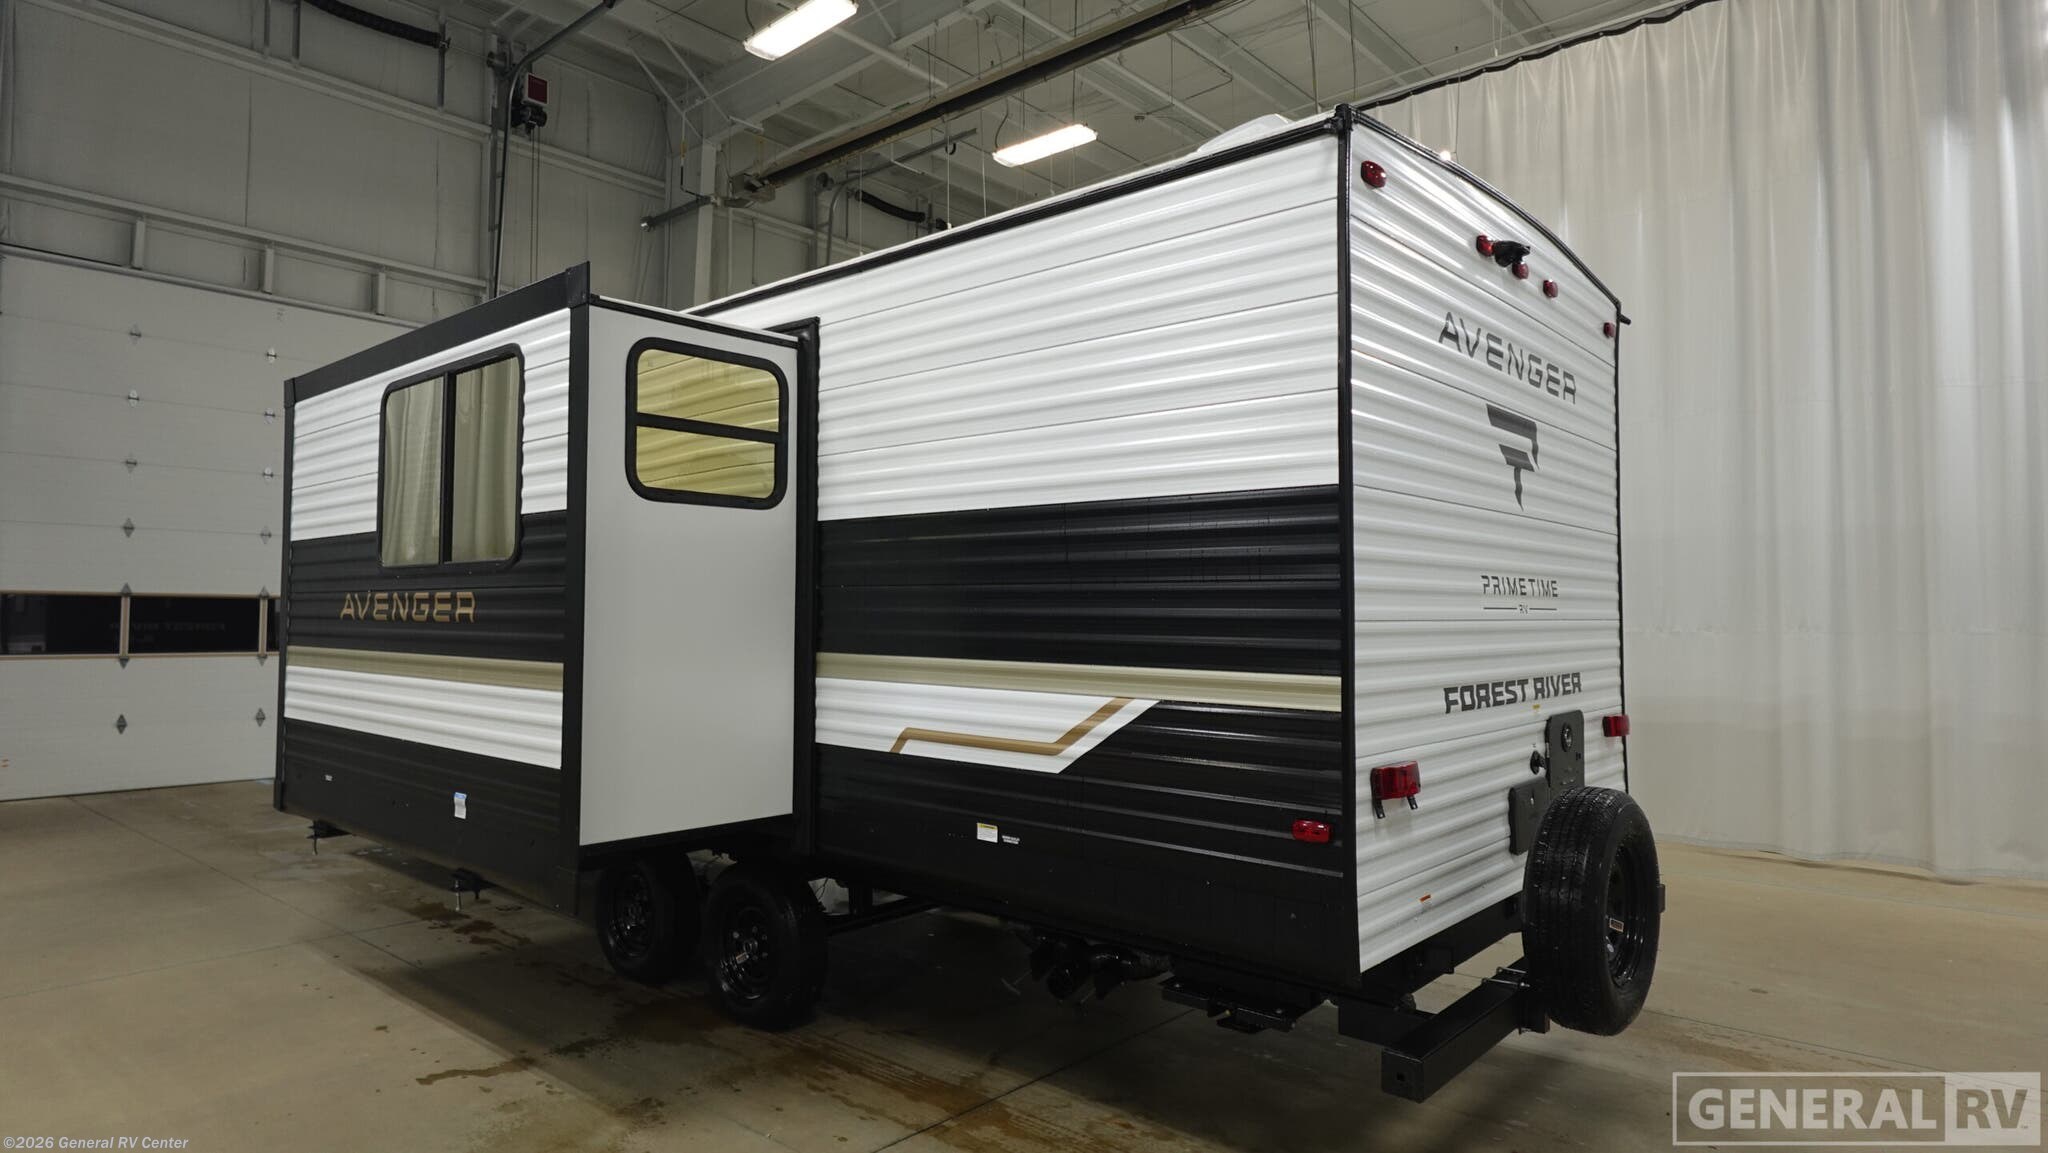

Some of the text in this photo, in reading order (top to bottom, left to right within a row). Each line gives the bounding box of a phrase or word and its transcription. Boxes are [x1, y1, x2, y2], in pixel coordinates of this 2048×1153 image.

[1439, 311, 1577, 404] AVENGER
[339, 590, 477, 622] AVENGER
[1443, 672, 1582, 714] FOREST RIVER
